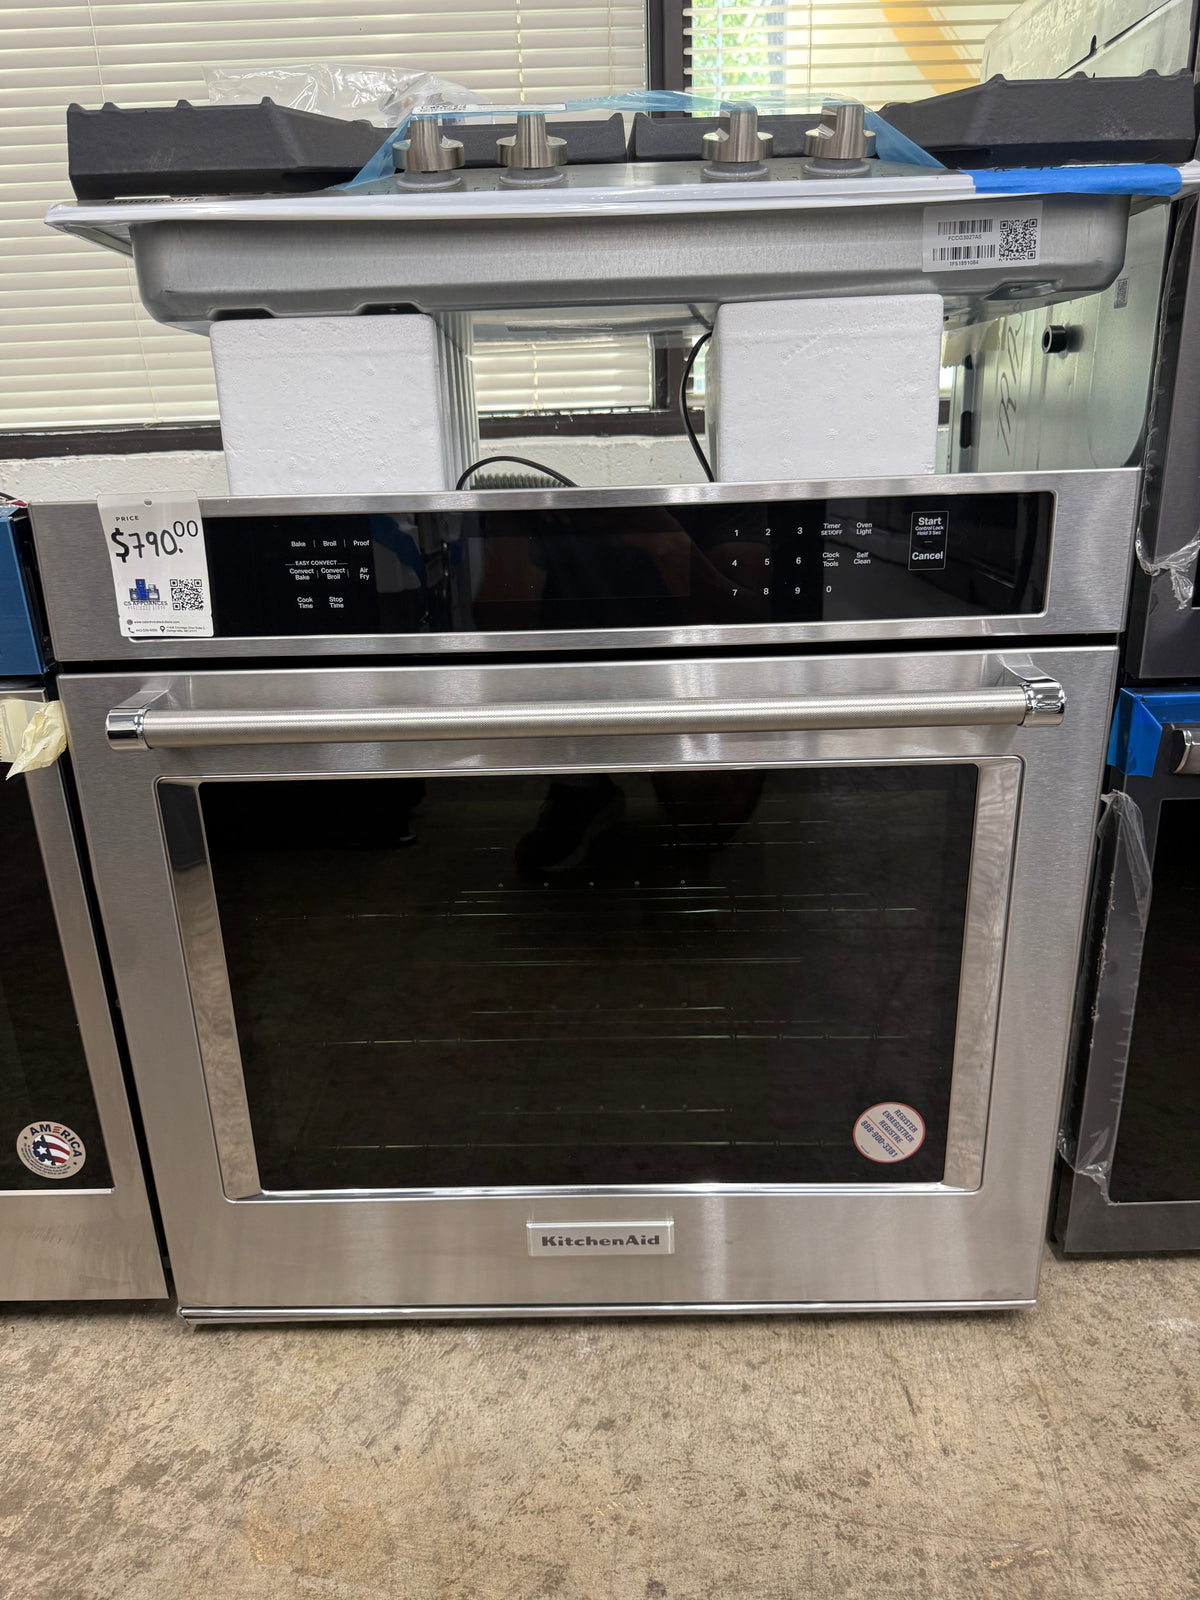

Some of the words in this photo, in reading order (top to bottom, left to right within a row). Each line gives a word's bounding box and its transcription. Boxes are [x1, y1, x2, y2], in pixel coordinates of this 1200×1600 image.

[918, 516, 942, 526] Start
[823, 522, 841, 530] Timer
[734, 529, 740, 537] 1
[765, 528, 771, 536] 2
[796, 526, 803, 535] 3
[856, 528, 873, 536] Light
[353, 539, 370, 547] Proof
[822, 551, 840, 559] Clock
[911, 551, 944, 561] Cancel
[731, 559, 738, 567] 4
[764, 558, 770, 566] 5
[795, 556, 801, 565] 6
[289, 567, 315, 575] Convect
[359, 573, 370, 581] Fry
[732, 589, 738, 597] 7
[763, 587, 769, 596] 8
[794, 586, 801, 595] 9
[825, 585, 832, 594] 0
[328, 596, 344, 604] Stop
[894, 1109, 918, 1133] REGISTER
[882, 1110, 914, 1142] ENREGISTRER
[879, 1120, 903, 1143] REGISTRE
[30, 1124, 82, 1157] AMERICA
[542, 1235, 660, 1246] KitchenAid
